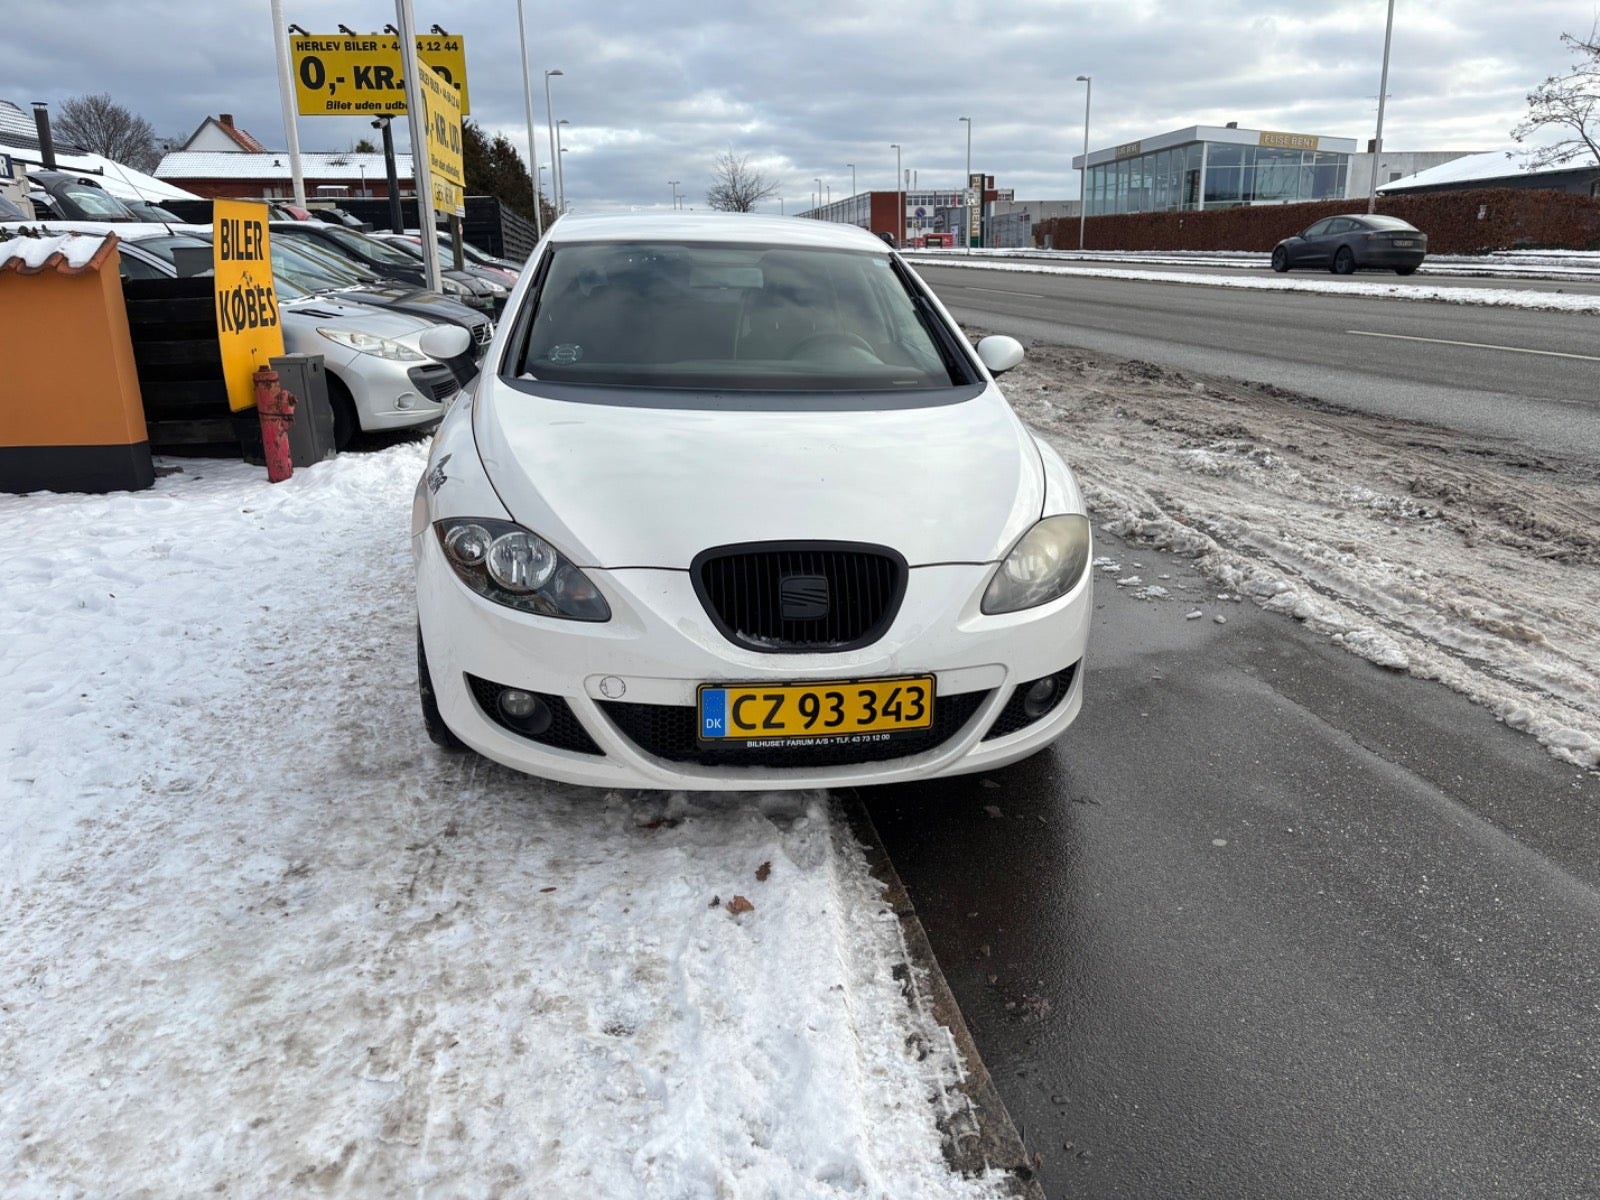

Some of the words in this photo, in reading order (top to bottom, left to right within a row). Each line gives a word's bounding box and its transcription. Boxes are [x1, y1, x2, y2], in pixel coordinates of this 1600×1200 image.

[296, 41, 341, 52] HERLEV
[344, 41, 378, 51] BILER
[391, 41, 401, 51] 4
[427, 41, 440, 51] 12
[444, 41, 458, 51] 44
[300, 56, 345, 96] 0,-
[431, 66, 461, 90] D.
[326, 101, 352, 110] Biler
[355, 101, 381, 110] uden
[220, 218, 264, 261] BILER
[219, 285, 277, 335] KØBES
[732, 694, 785, 730] CZ
[798, 692, 844, 730] 93
[856, 686, 925, 725] 343
[706, 718, 721, 729] DK
[747, 740, 785, 748] BILHUSET
[786, 739, 814, 747] FARUM
